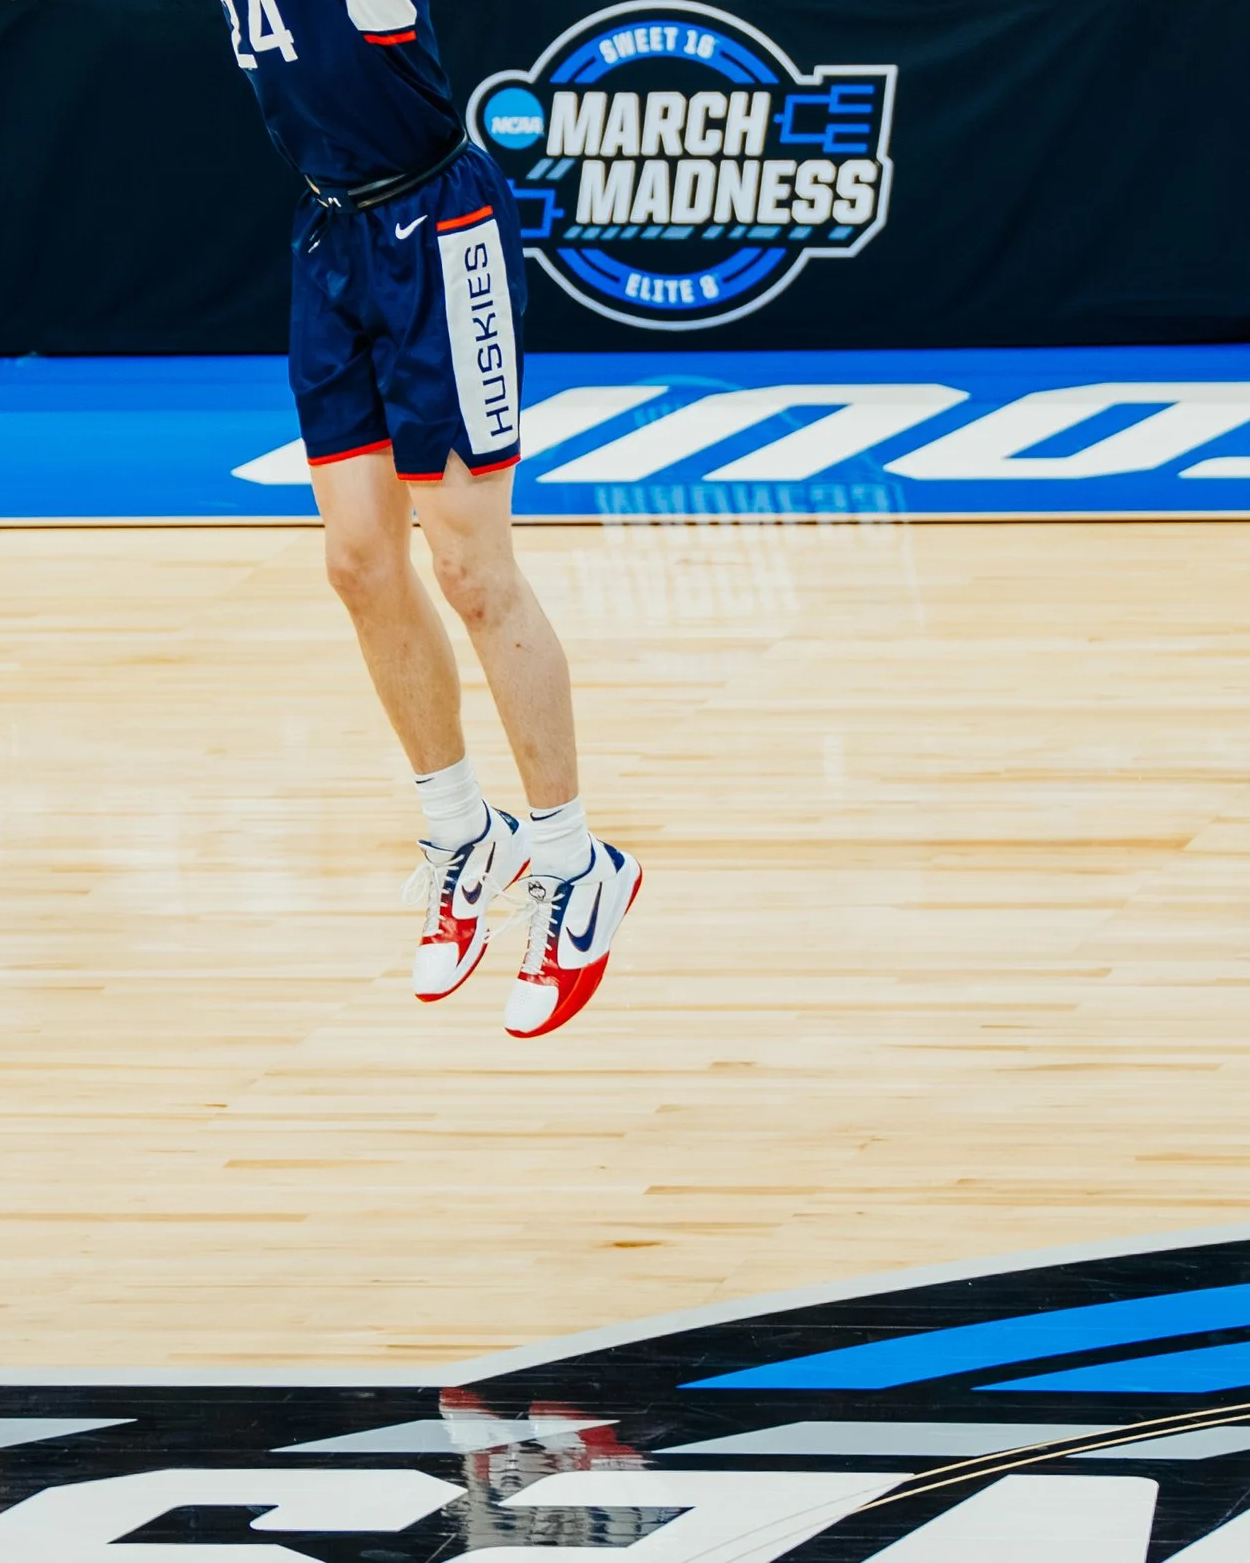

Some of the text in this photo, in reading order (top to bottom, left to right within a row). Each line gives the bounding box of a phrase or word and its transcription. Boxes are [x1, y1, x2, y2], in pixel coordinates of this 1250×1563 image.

[598, 26, 716, 64] SWEET 16
[491, 116, 544, 135] NCAA
[546, 91, 772, 156] MARCH
[575, 159, 879, 225] MADNESS
[625, 272, 720, 303] ELITE 8
[464, 242, 514, 438] HUSKIES
